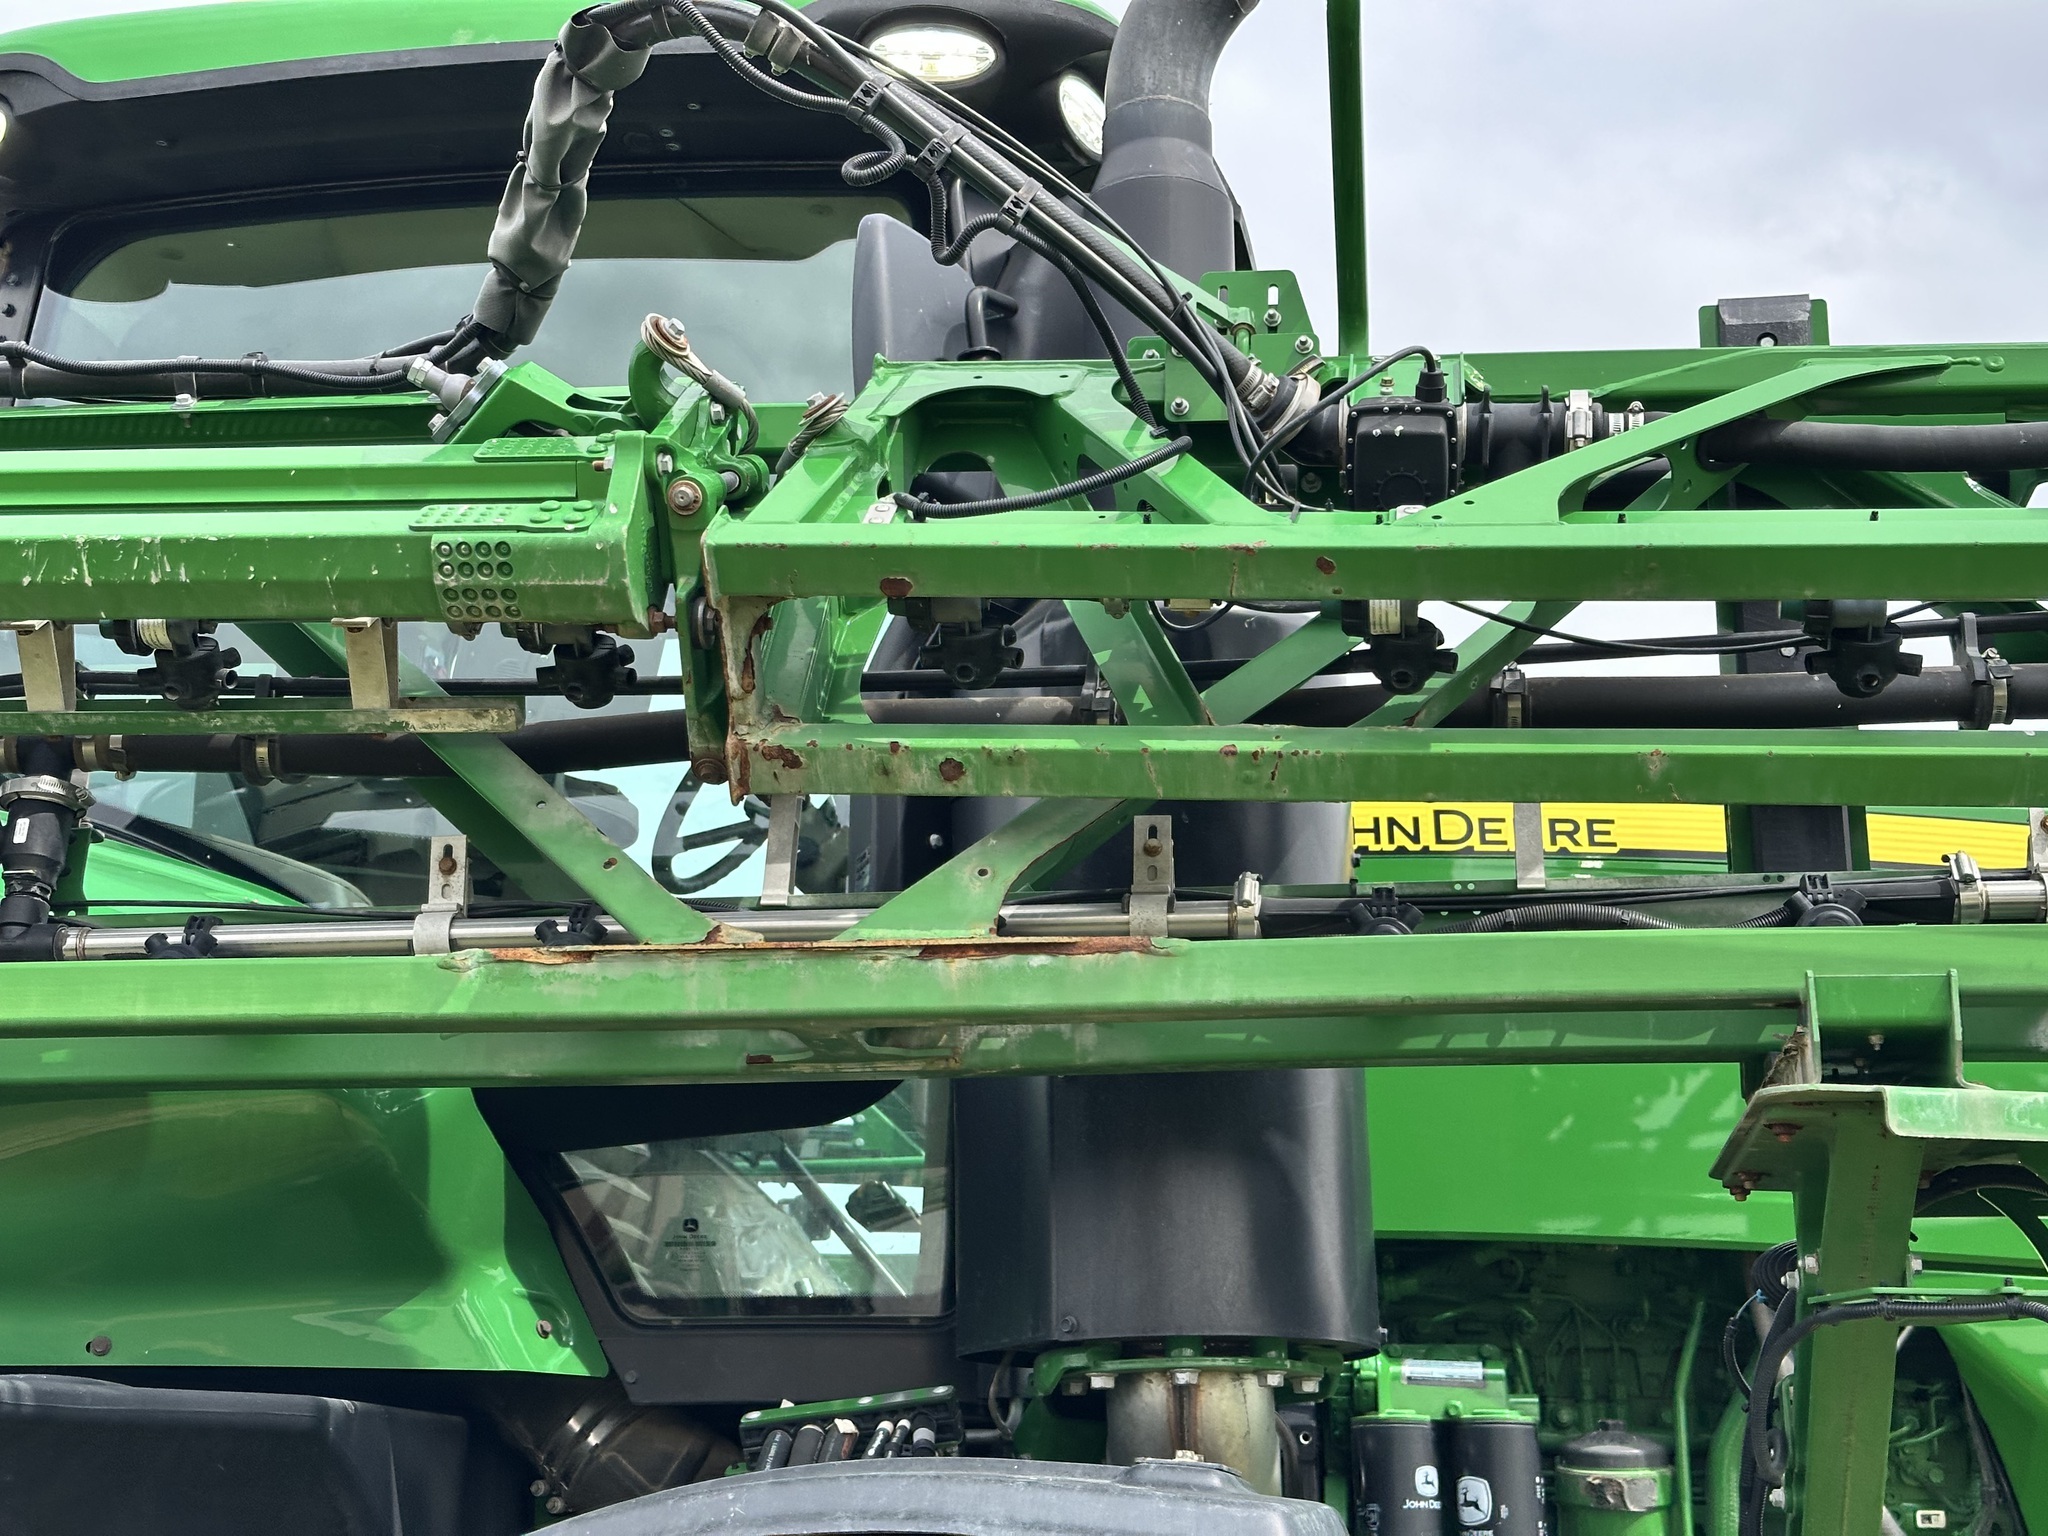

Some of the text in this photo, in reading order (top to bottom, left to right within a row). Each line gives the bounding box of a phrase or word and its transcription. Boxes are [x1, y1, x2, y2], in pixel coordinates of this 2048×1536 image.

[1353, 809, 1617, 847] HN DERE
[1402, 1498, 1429, 1509] JOHN
